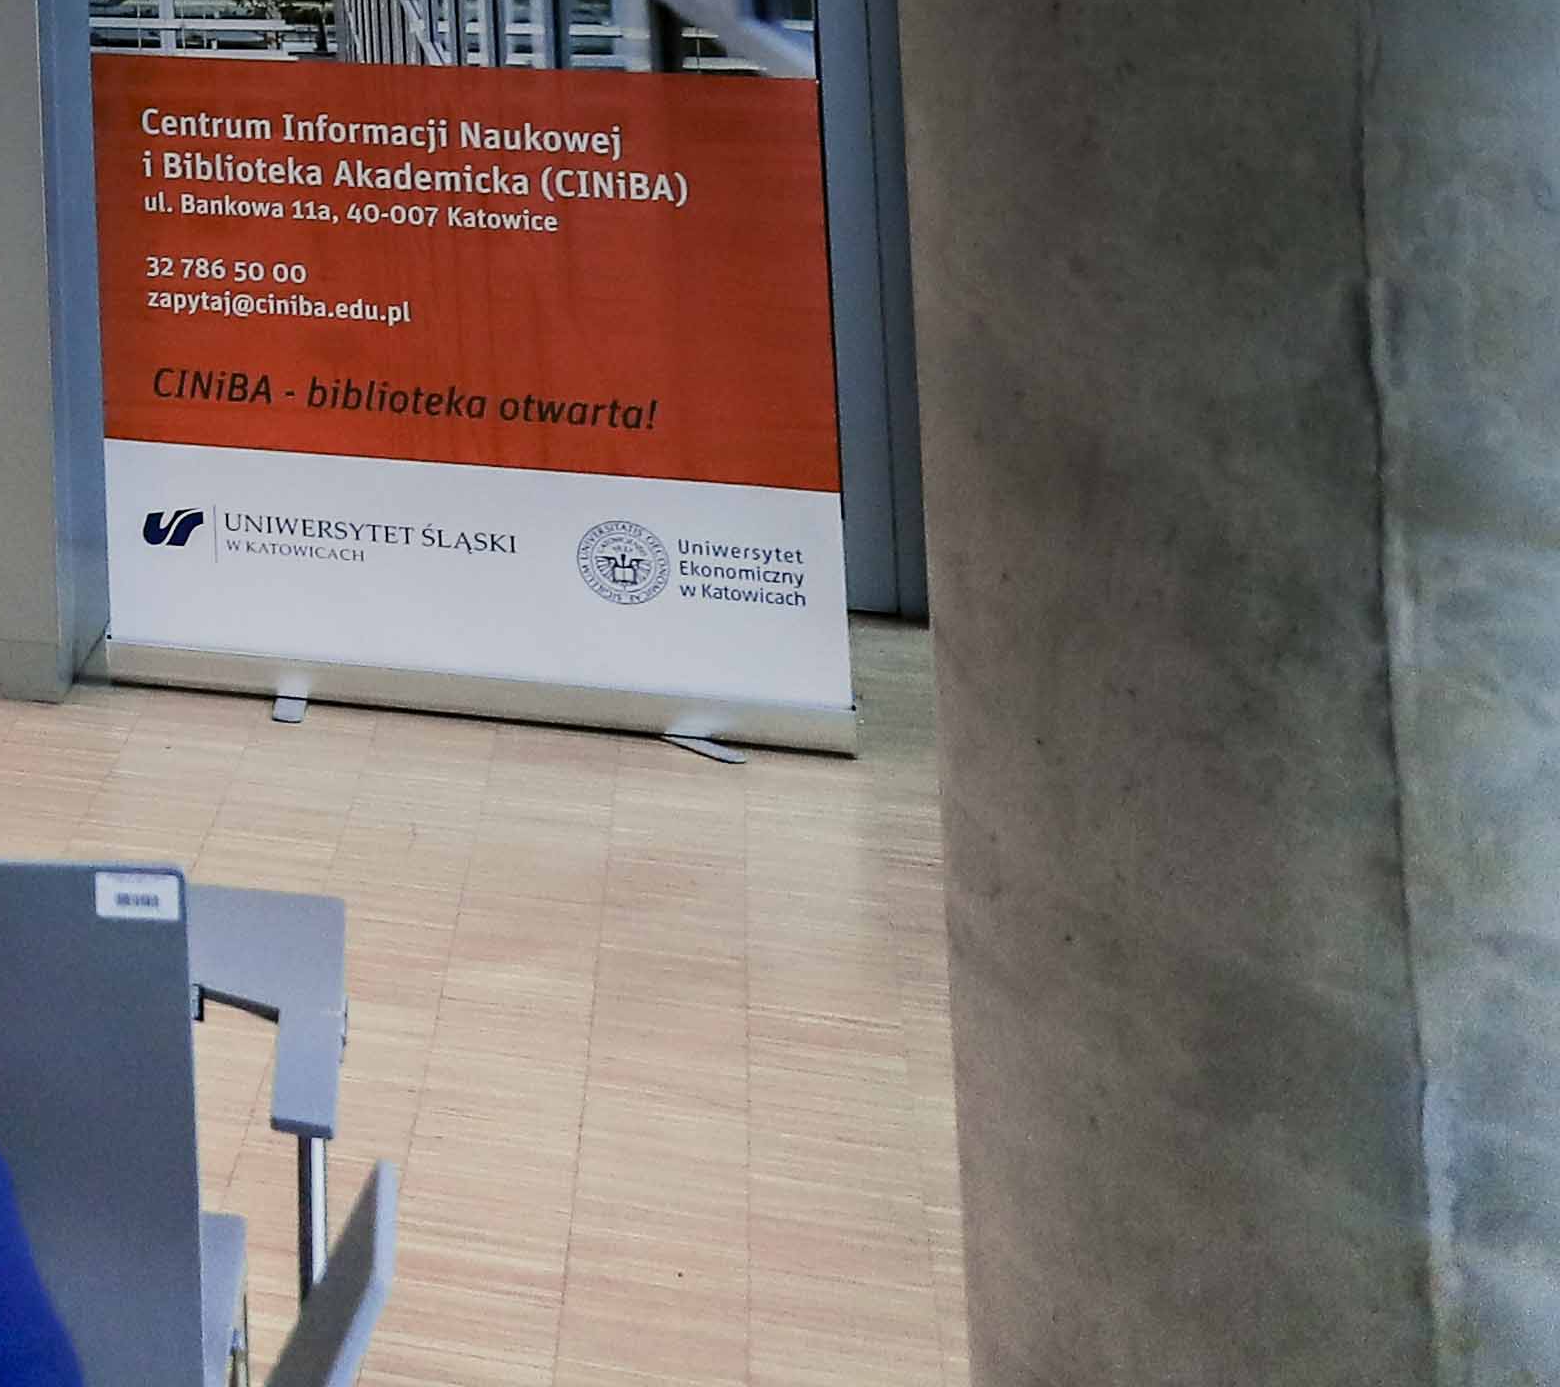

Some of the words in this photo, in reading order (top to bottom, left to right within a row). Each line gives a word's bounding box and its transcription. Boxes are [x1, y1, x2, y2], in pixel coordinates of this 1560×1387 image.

[141, 107, 271, 140] Centrum
[282, 112, 448, 154] Informacji
[460, 120, 621, 161] Naukowej
[142, 150, 152, 177] i
[163, 152, 322, 187] Biblioteka
[333, 159, 530, 196] Akademicka
[540, 166, 688, 207] (CINiBA)
[144, 191, 173, 213] ul.
[181, 193, 284, 219] Bankowa
[291, 200, 339, 224] 11a,
[346, 203, 439, 227] 40-007
[447, 206, 559, 232] Katowice
[146, 256, 174, 277] 32
[180, 257, 226, 280] 786
[233, 261, 265, 283] 50
[272, 263, 307, 284] 00
[147, 290, 411, 327] zapytaj@ciniba.edu.pl
[153, 367, 273, 405] CINiBA
[307, 375, 487, 419] biblioteka
[499, 391, 658, 430] otwarta!
[224, 512, 415, 546] UNIWERSYTET
[421, 523, 518, 555] ŚLĄSKI
[226, 539, 242, 552] W
[246, 540, 365, 562] KATOWICACH
[678, 538, 803, 565] Uniwersytet
[679, 560, 804, 588] Ekonomiczny
[680, 585, 696, 597] w
[702, 583, 806, 607] Katowicach
